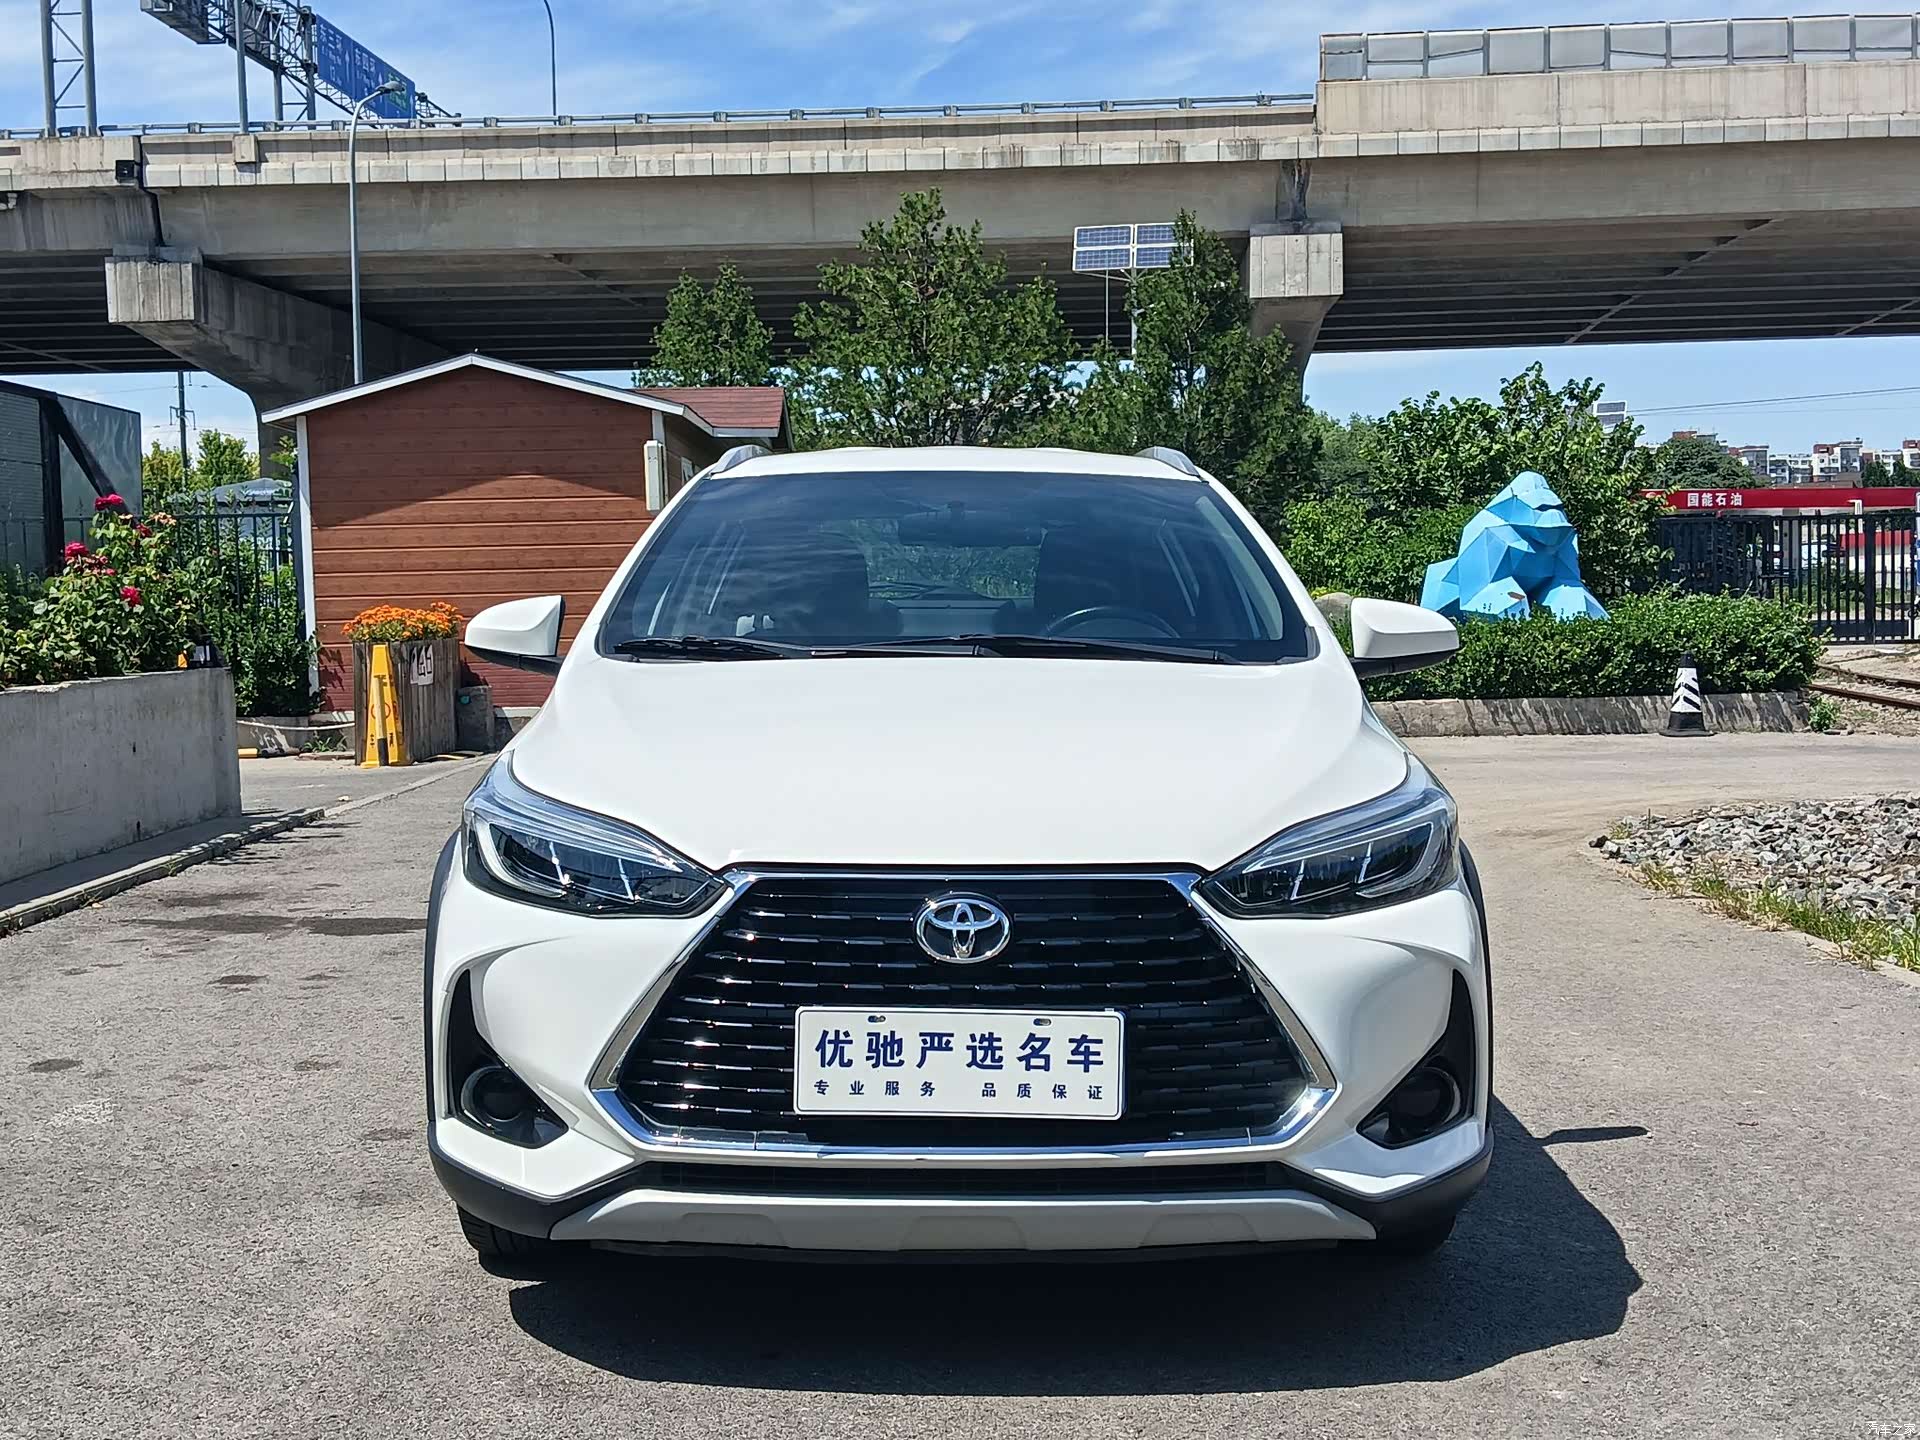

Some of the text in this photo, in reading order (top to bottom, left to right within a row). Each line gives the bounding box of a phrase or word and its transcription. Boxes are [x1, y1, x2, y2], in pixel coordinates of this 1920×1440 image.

[1687, 492, 1742, 507] 国能石油
[815, 1029, 1103, 1073] 优驰严选名车
[813, 1079, 1103, 1100] 专业服务 品质保证
